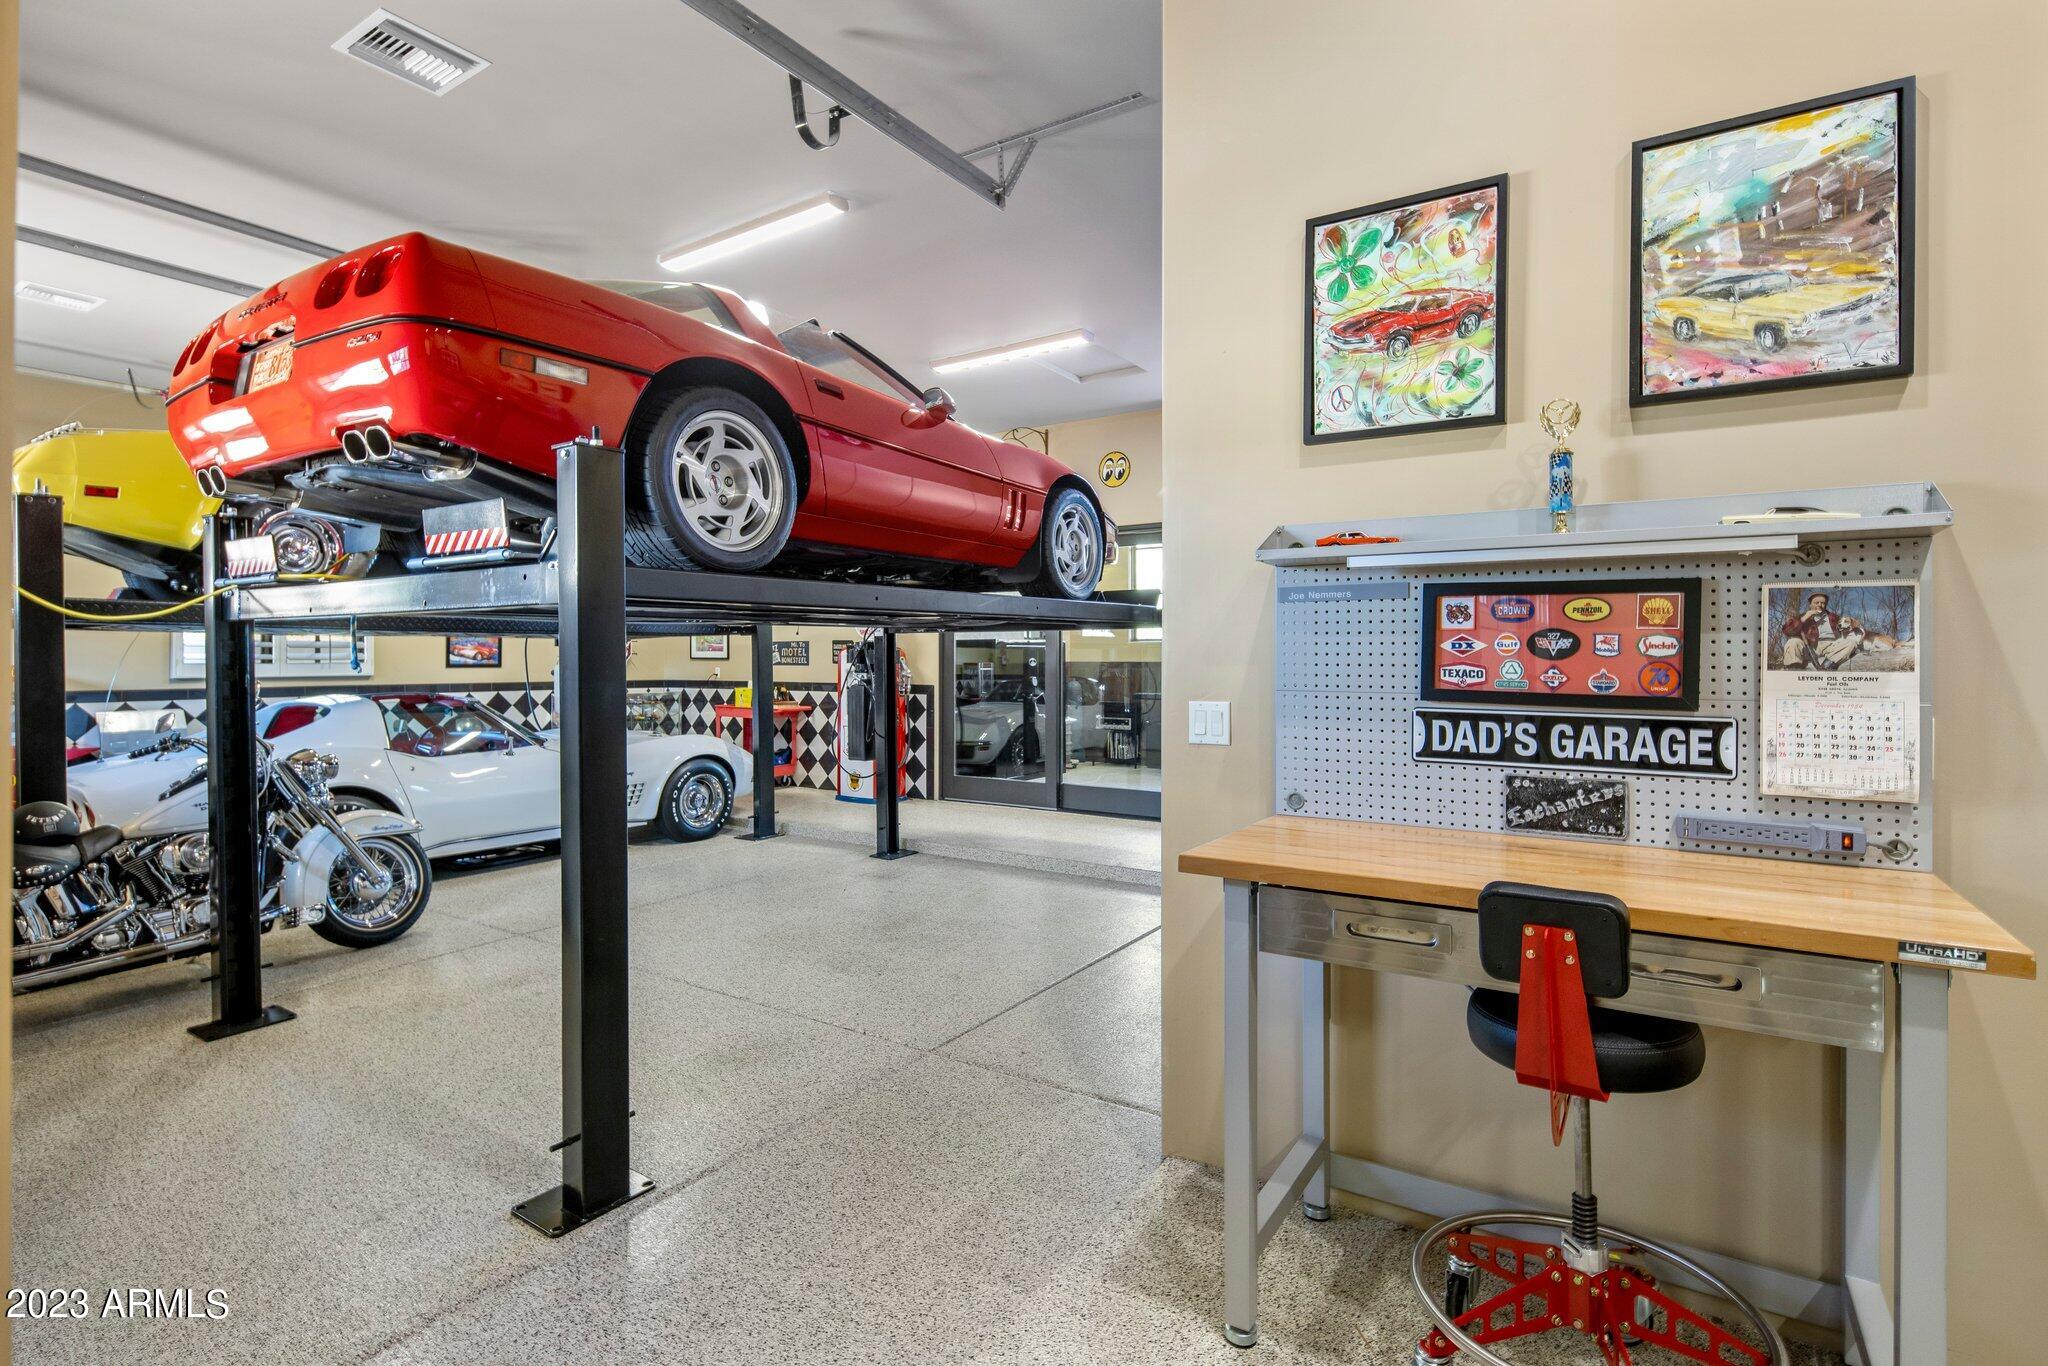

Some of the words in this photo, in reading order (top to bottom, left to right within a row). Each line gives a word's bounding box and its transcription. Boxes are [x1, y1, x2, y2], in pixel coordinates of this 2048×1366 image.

[1288, 592, 1305, 600] Joe
[1308, 591, 1352, 599] Nemmers
[1498, 606, 1527, 616] CROWN
[1572, 606, 1604, 614] PENNZOIL
[1645, 607, 1670, 615] SHELL
[1546, 632, 1561, 640] 327
[1450, 641, 1476, 649] DX
[1642, 637, 1678, 654] Sinclair
[781, 648, 807, 657] MOTEL
[1442, 668, 1484, 679] TEXACO
[1649, 667, 1670, 686] 76
[1431, 719, 1538, 757] DAD'S
[1550, 723, 1713, 767] GARAGE
[1508, 784, 1625, 827] Enchanters
[26, 809, 67, 823] VETERAN
